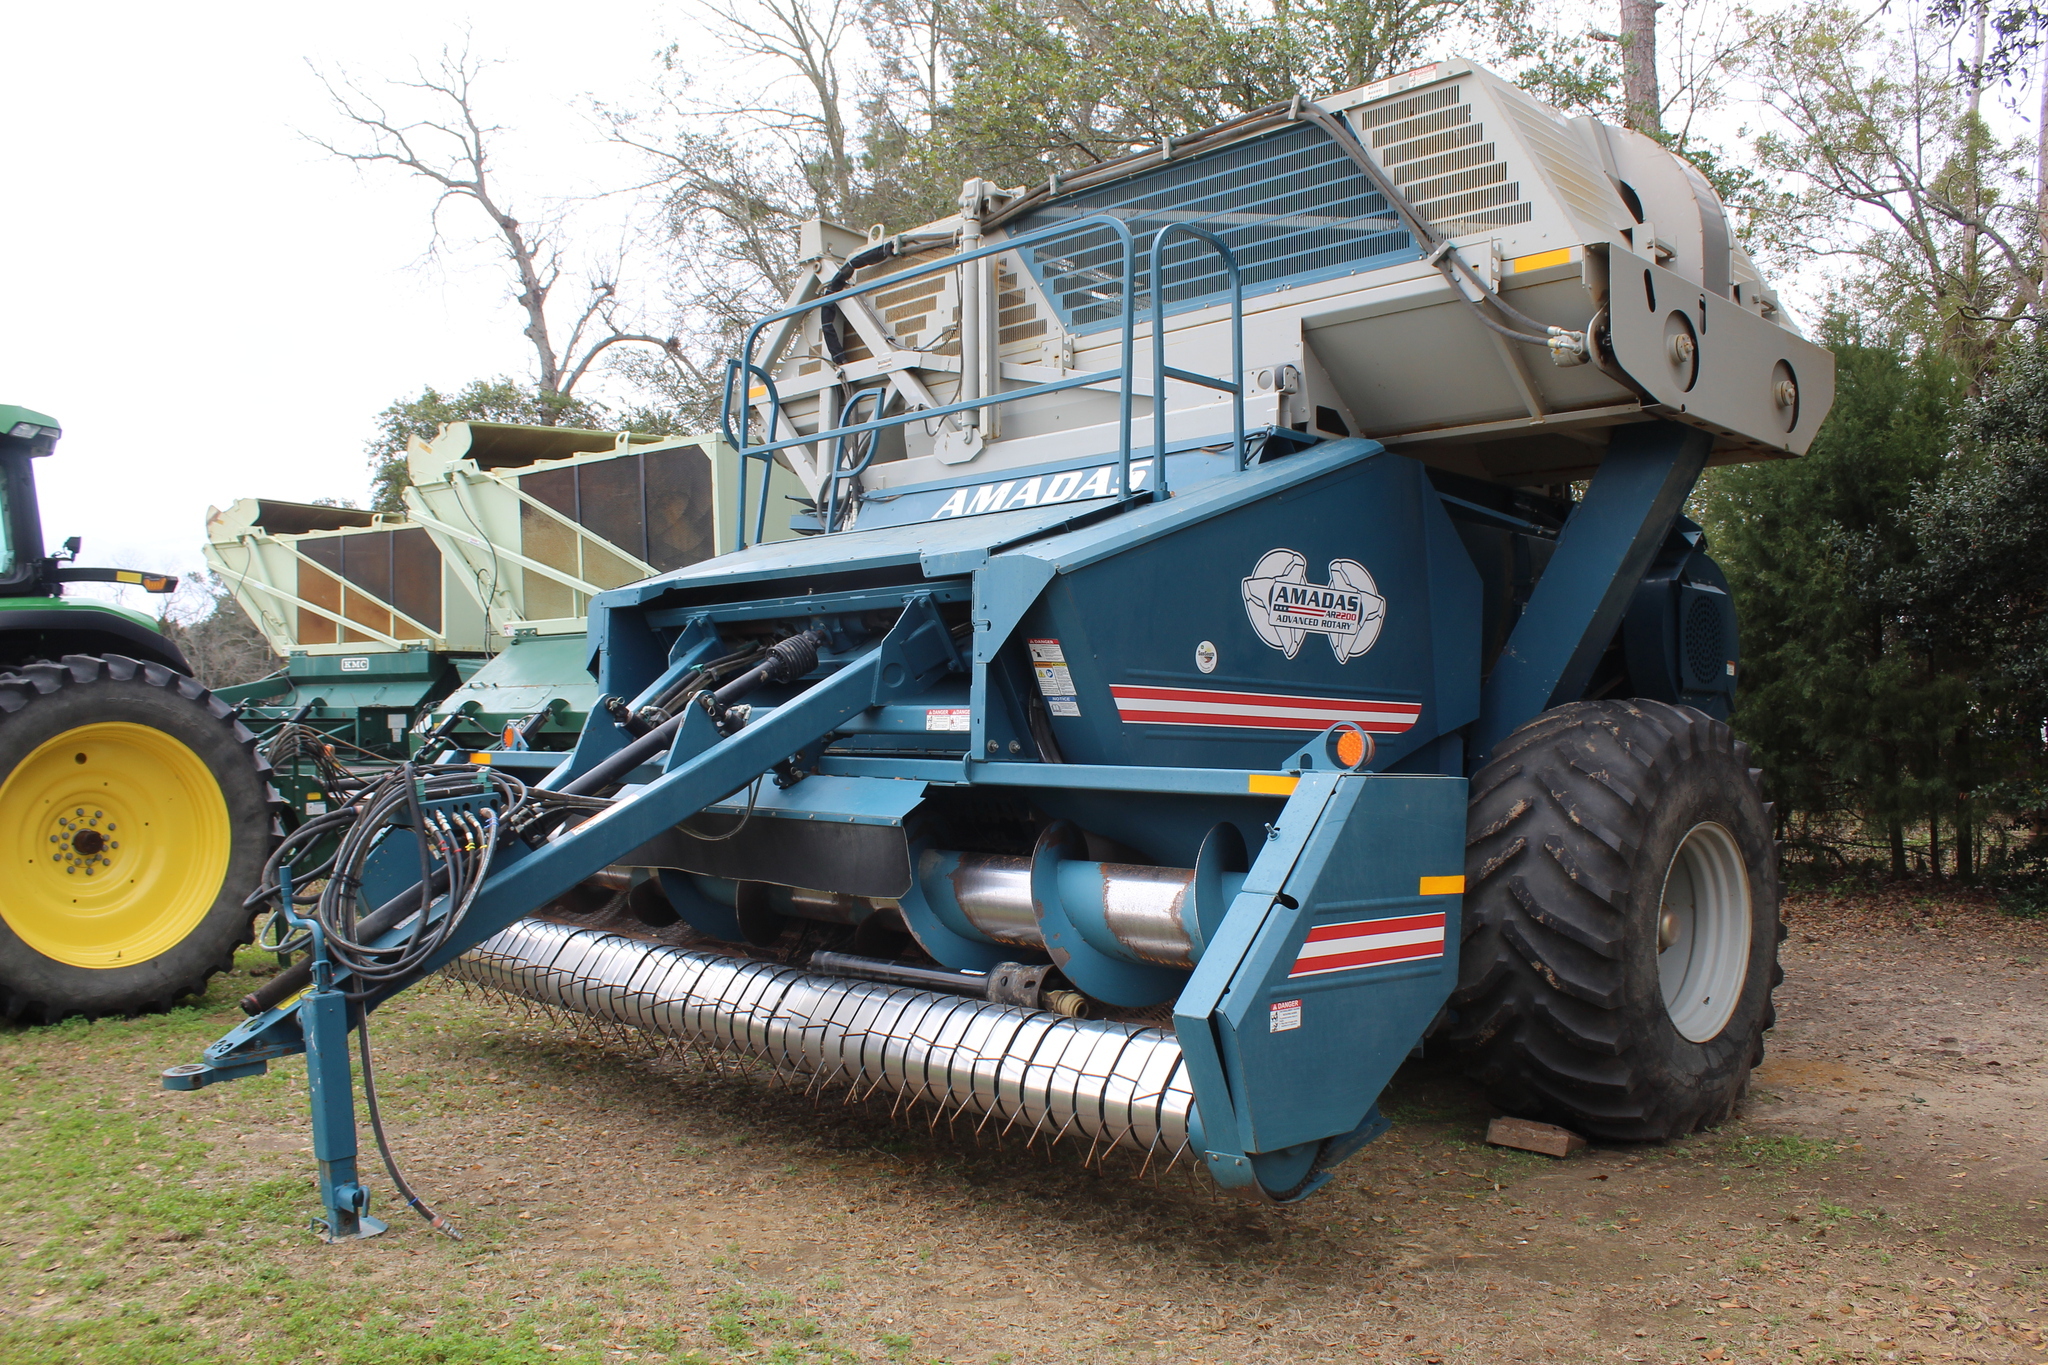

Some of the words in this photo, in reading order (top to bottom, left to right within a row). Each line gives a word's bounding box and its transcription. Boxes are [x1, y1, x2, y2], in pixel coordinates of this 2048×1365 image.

[931, 460, 1154, 519] AMADAS
[1275, 586, 1359, 611] AMADAS
[1276, 614, 1319, 627] ADVANCED
[1325, 611, 1357, 621] AR2200
[1277, 1000, 1299, 1010] DANGER
